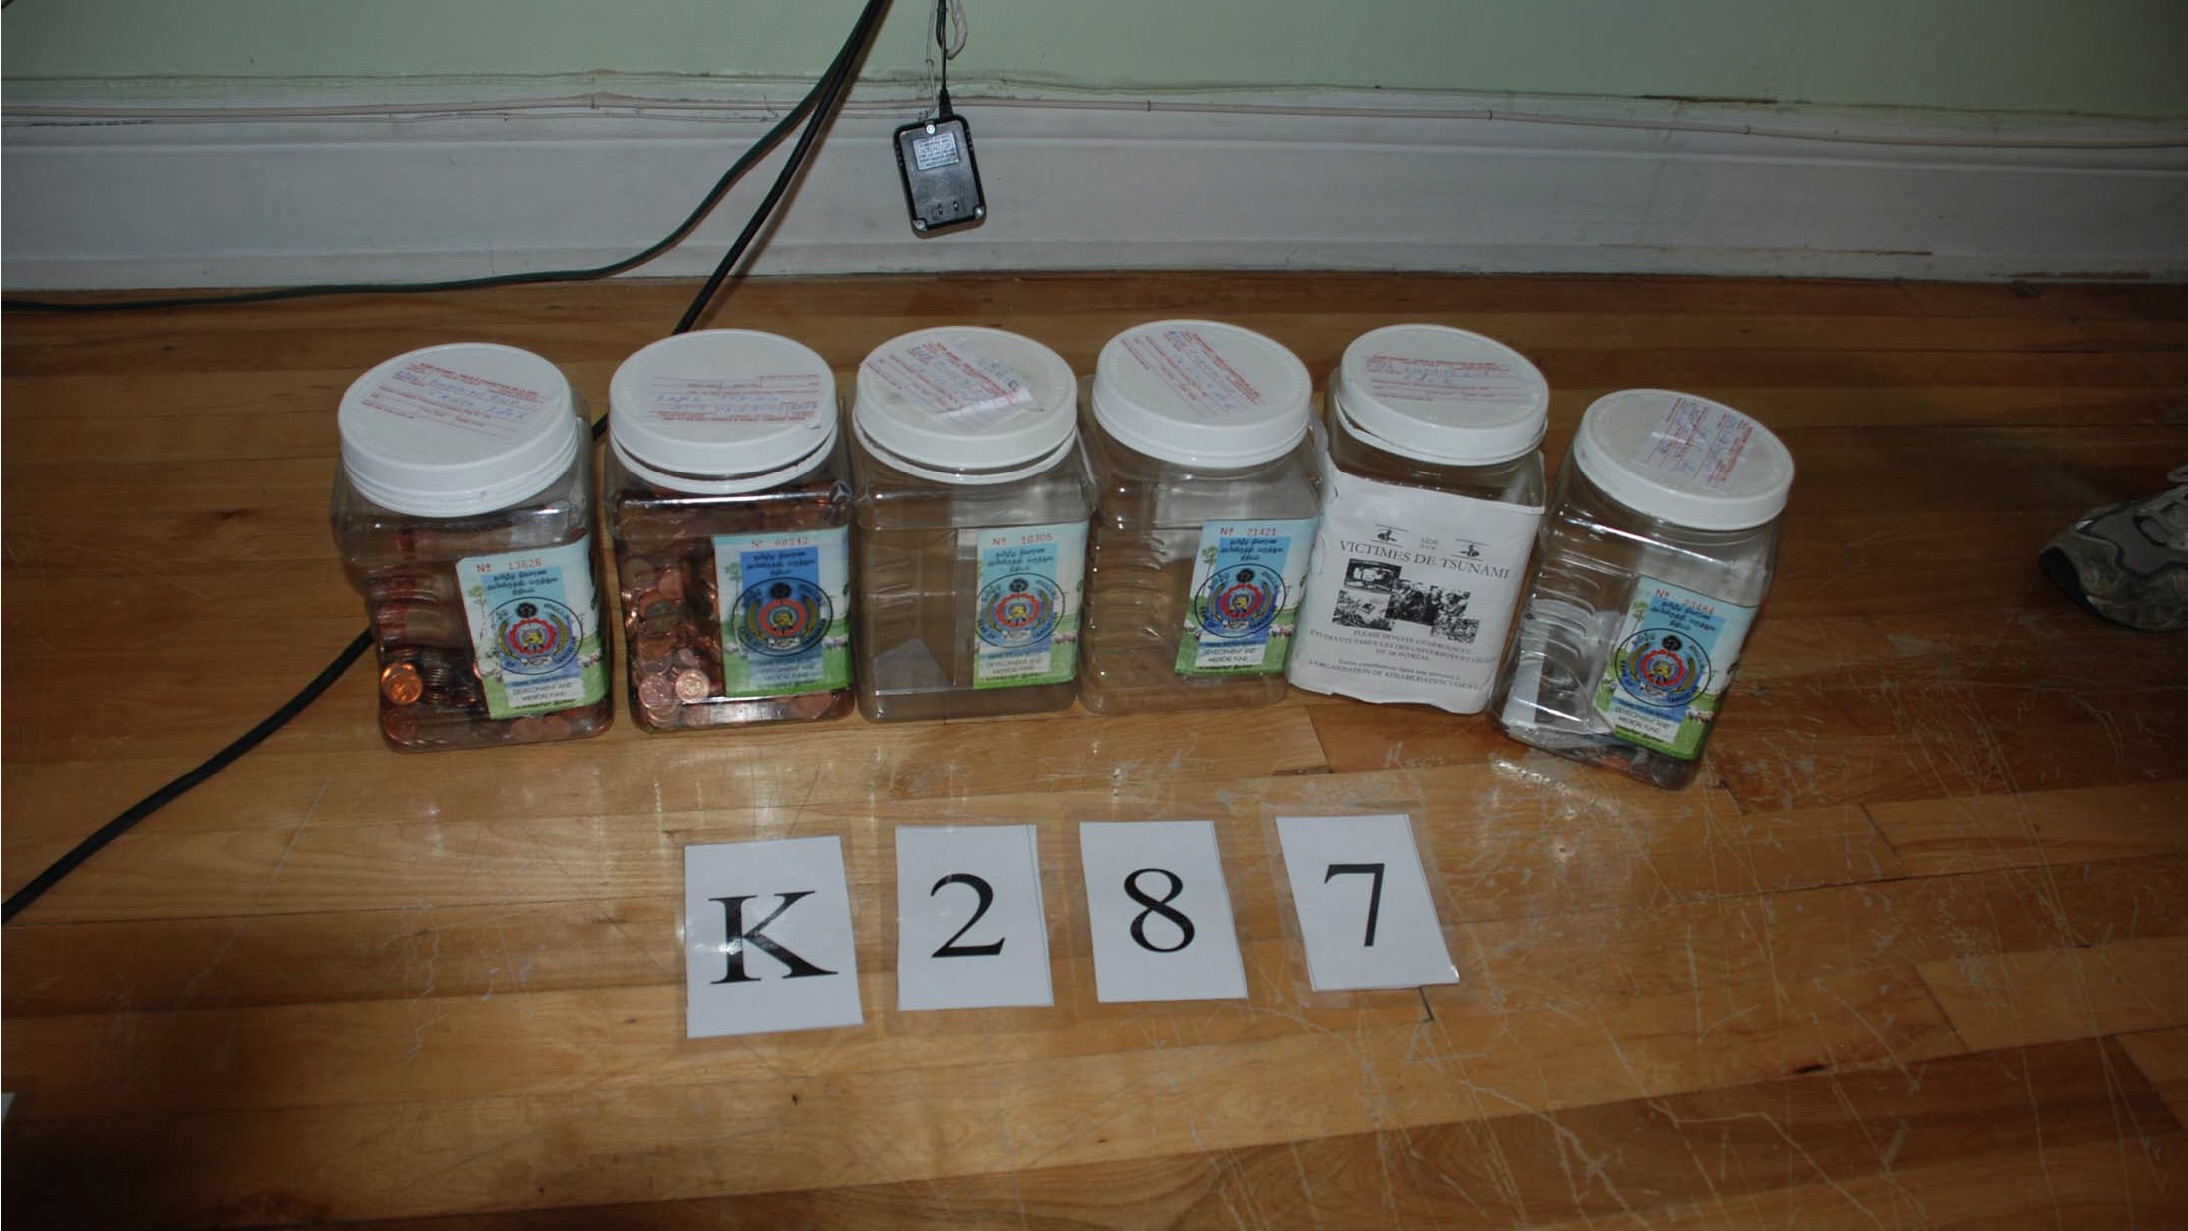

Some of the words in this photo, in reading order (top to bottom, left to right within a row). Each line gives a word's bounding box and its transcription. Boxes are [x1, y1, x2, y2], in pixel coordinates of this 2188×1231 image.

[1022, 533, 1053, 545] 10305
[1340, 540, 1411, 563] VICTIMES
[1414, 554, 1437, 566] DE
[1441, 558, 1510, 579] TSUNAMI
[709, 891, 837, 984] K
[931, 874, 1005, 958] 2
[1124, 869, 1195, 952] 8
[1325, 863, 1384, 946] 7
